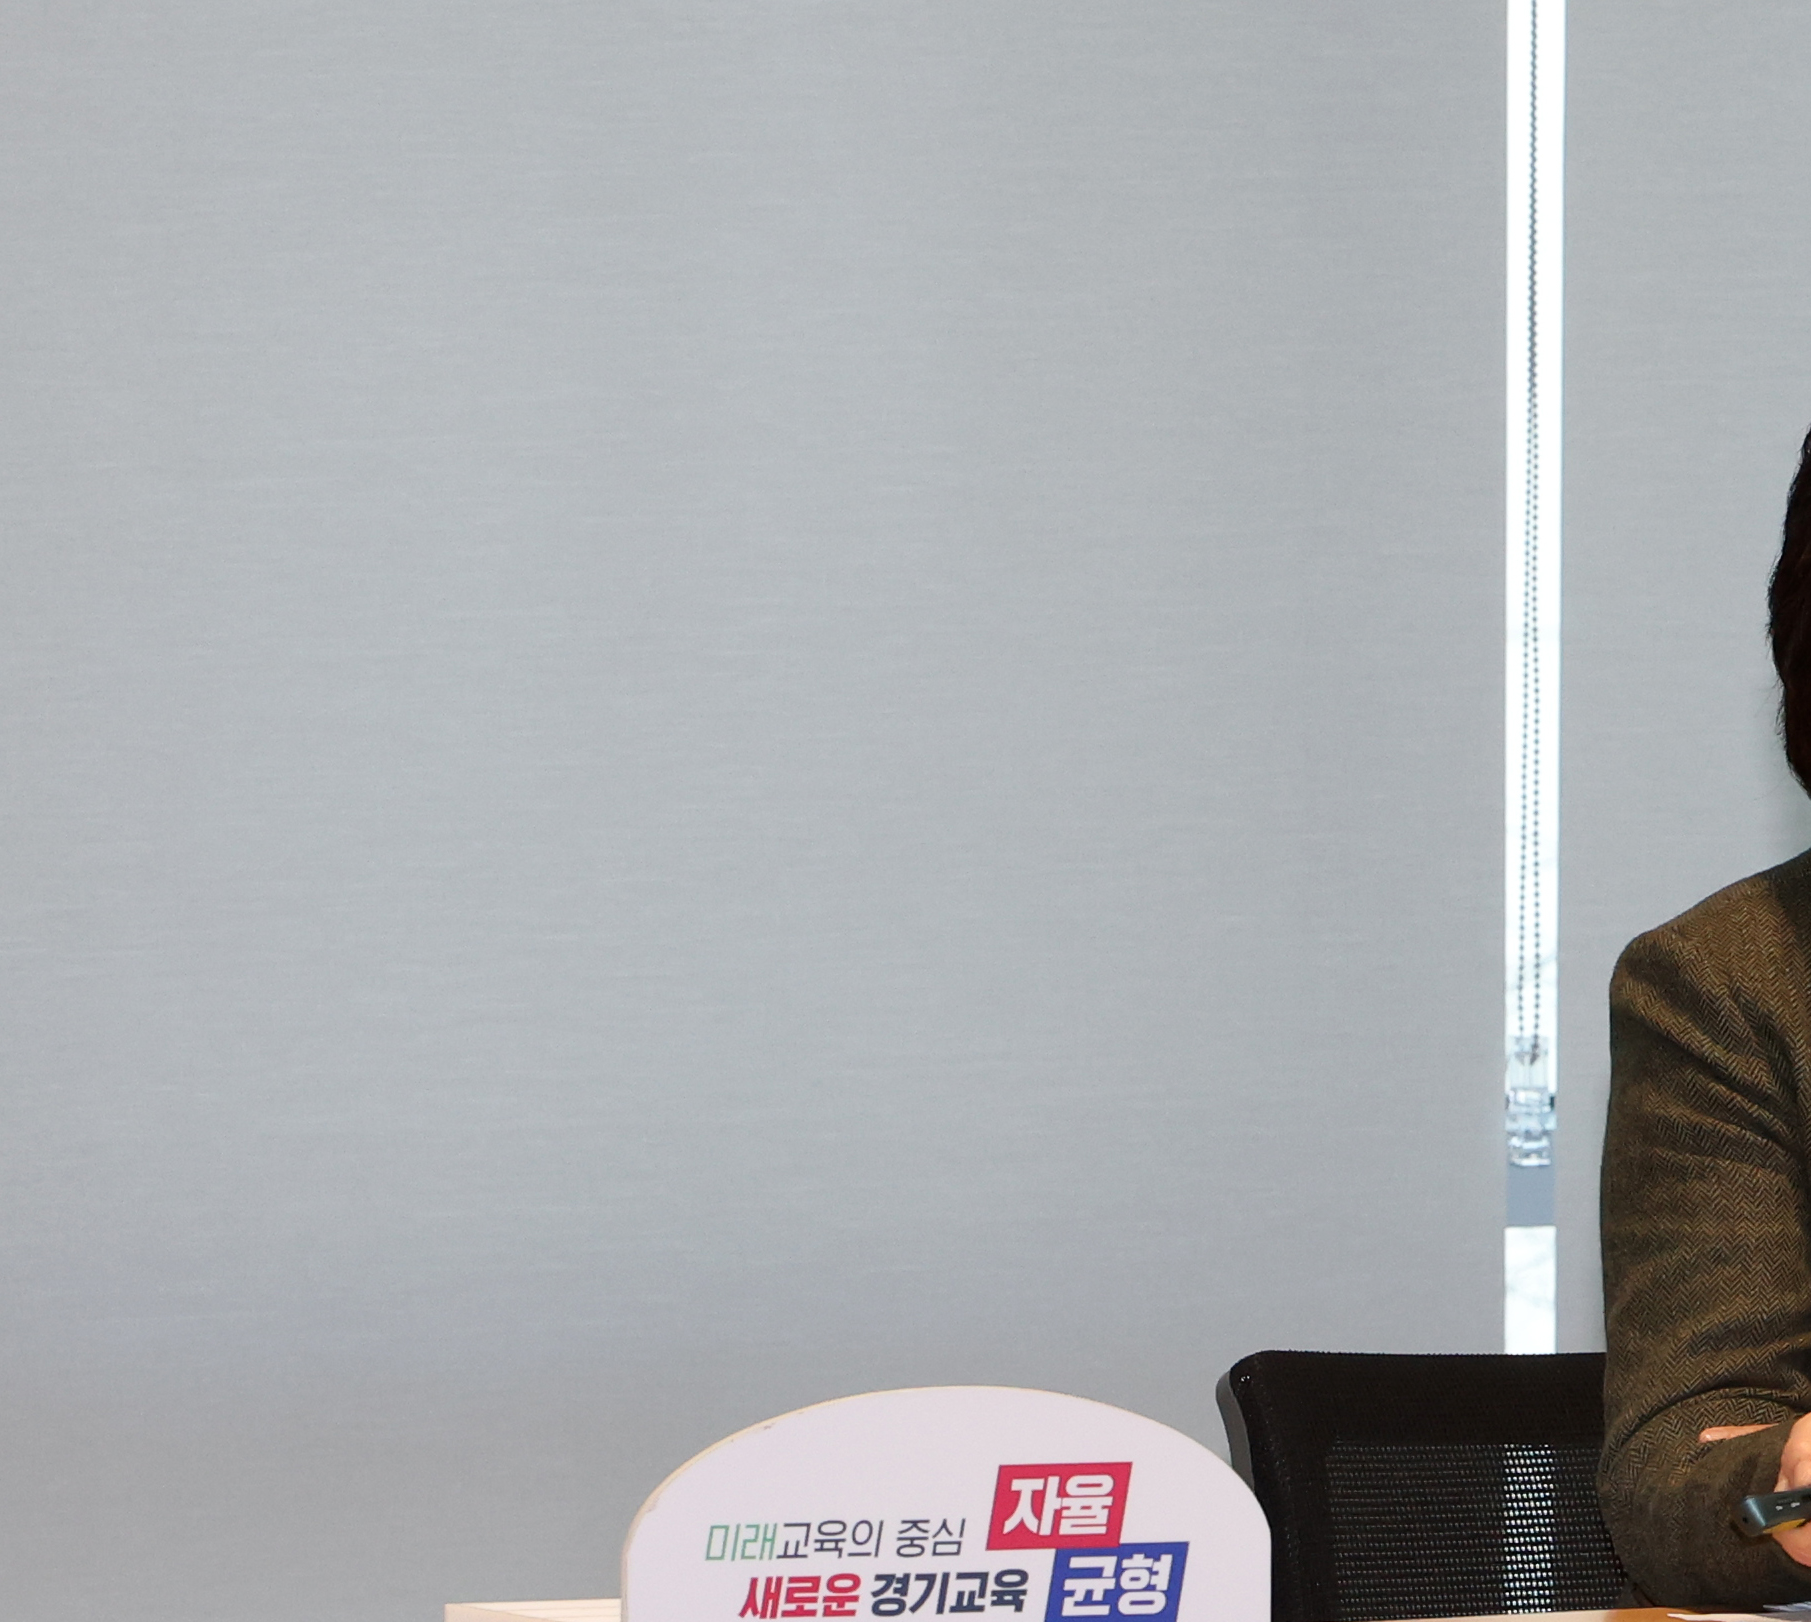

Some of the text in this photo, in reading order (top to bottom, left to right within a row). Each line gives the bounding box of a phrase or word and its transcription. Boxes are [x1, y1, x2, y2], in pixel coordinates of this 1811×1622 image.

[1003, 1474, 1114, 1536] 자율
[705, 1518, 966, 1562] 미래교육의 중심
[738, 1568, 1029, 1619] 새로운 경기교육
[1061, 1553, 1173, 1617] 균형
